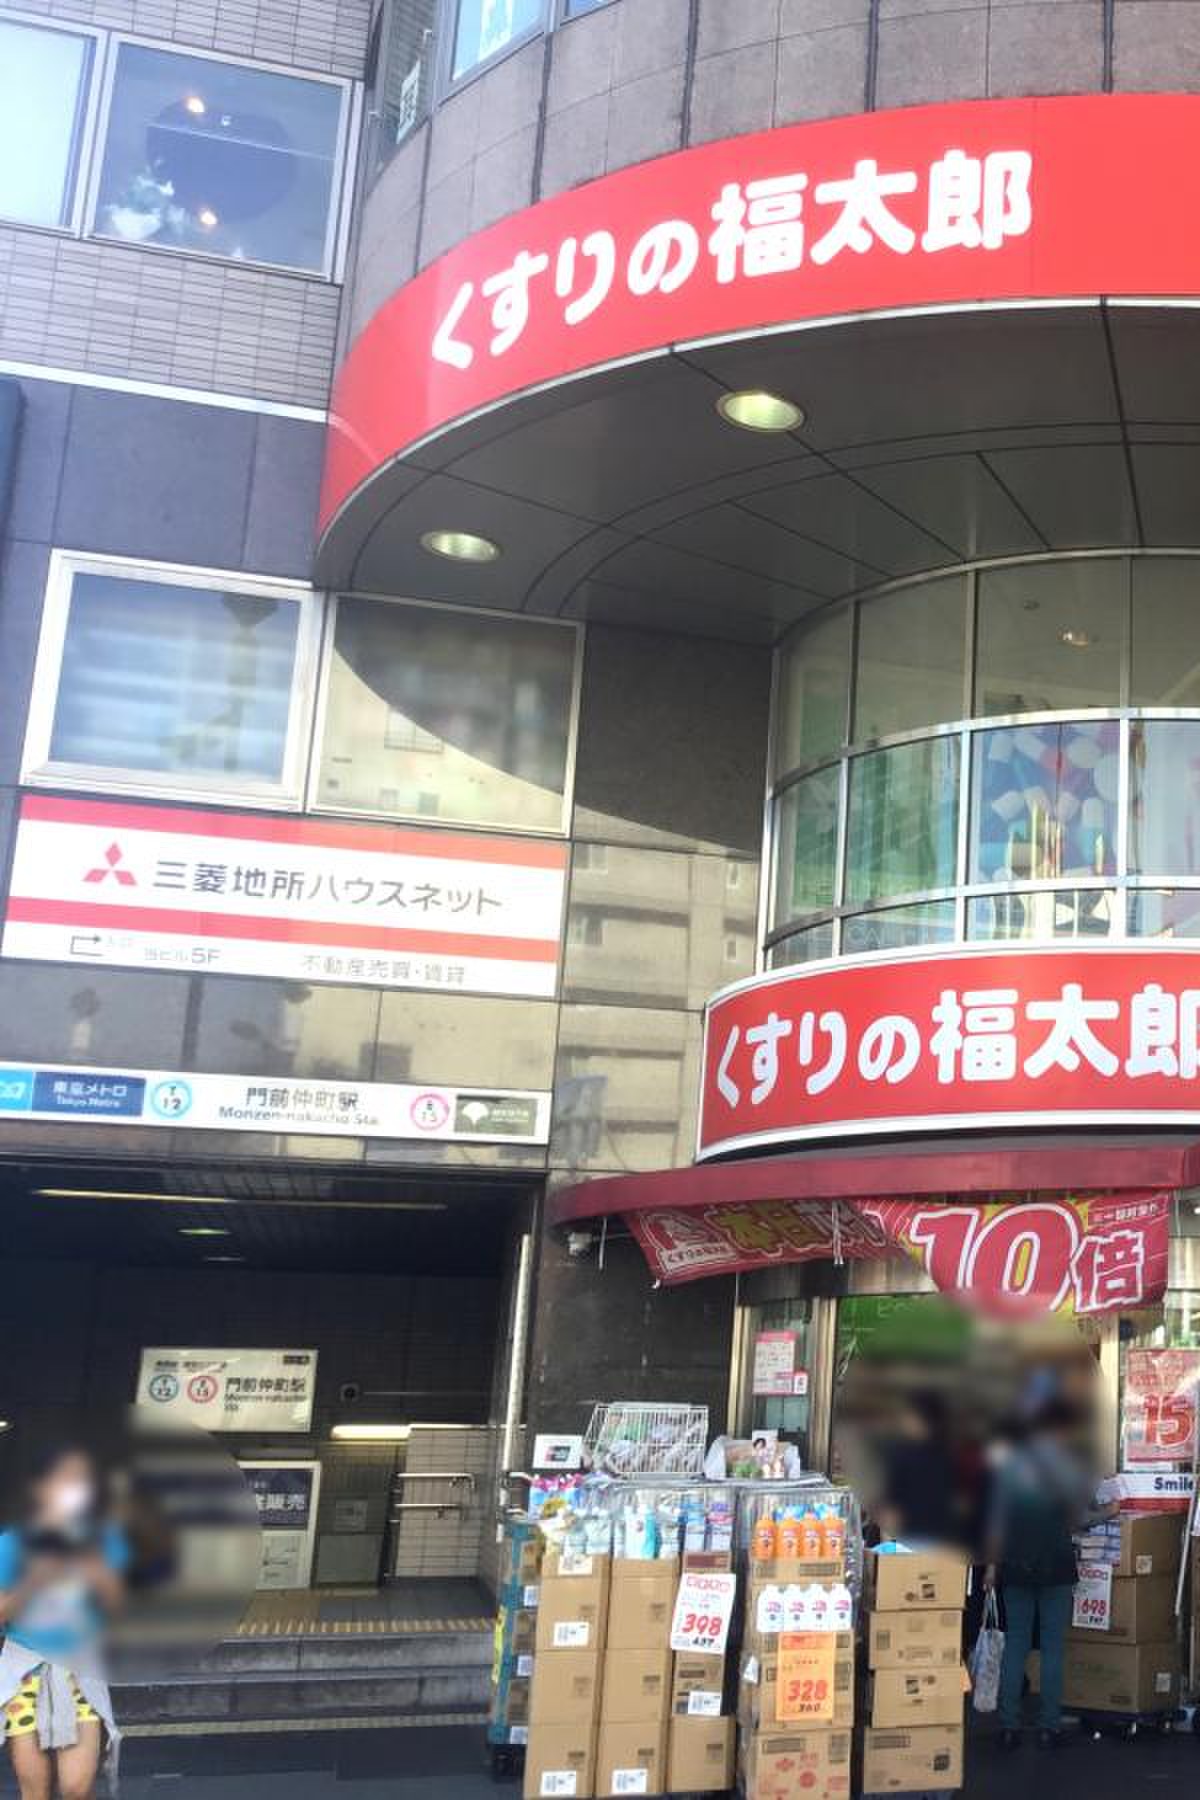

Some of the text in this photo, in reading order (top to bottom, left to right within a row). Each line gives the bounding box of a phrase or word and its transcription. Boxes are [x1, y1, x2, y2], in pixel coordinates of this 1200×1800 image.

[431, 150, 1033, 369] くすりの福太郎
[153, 860, 502, 916] 三菱地所ハウスネット
[53, 1080, 127, 1098] 東京メトロ
[246, 1087, 359, 1111] 門前仲町駅
[225, 1376, 306, 1393] 門前仲町駅
